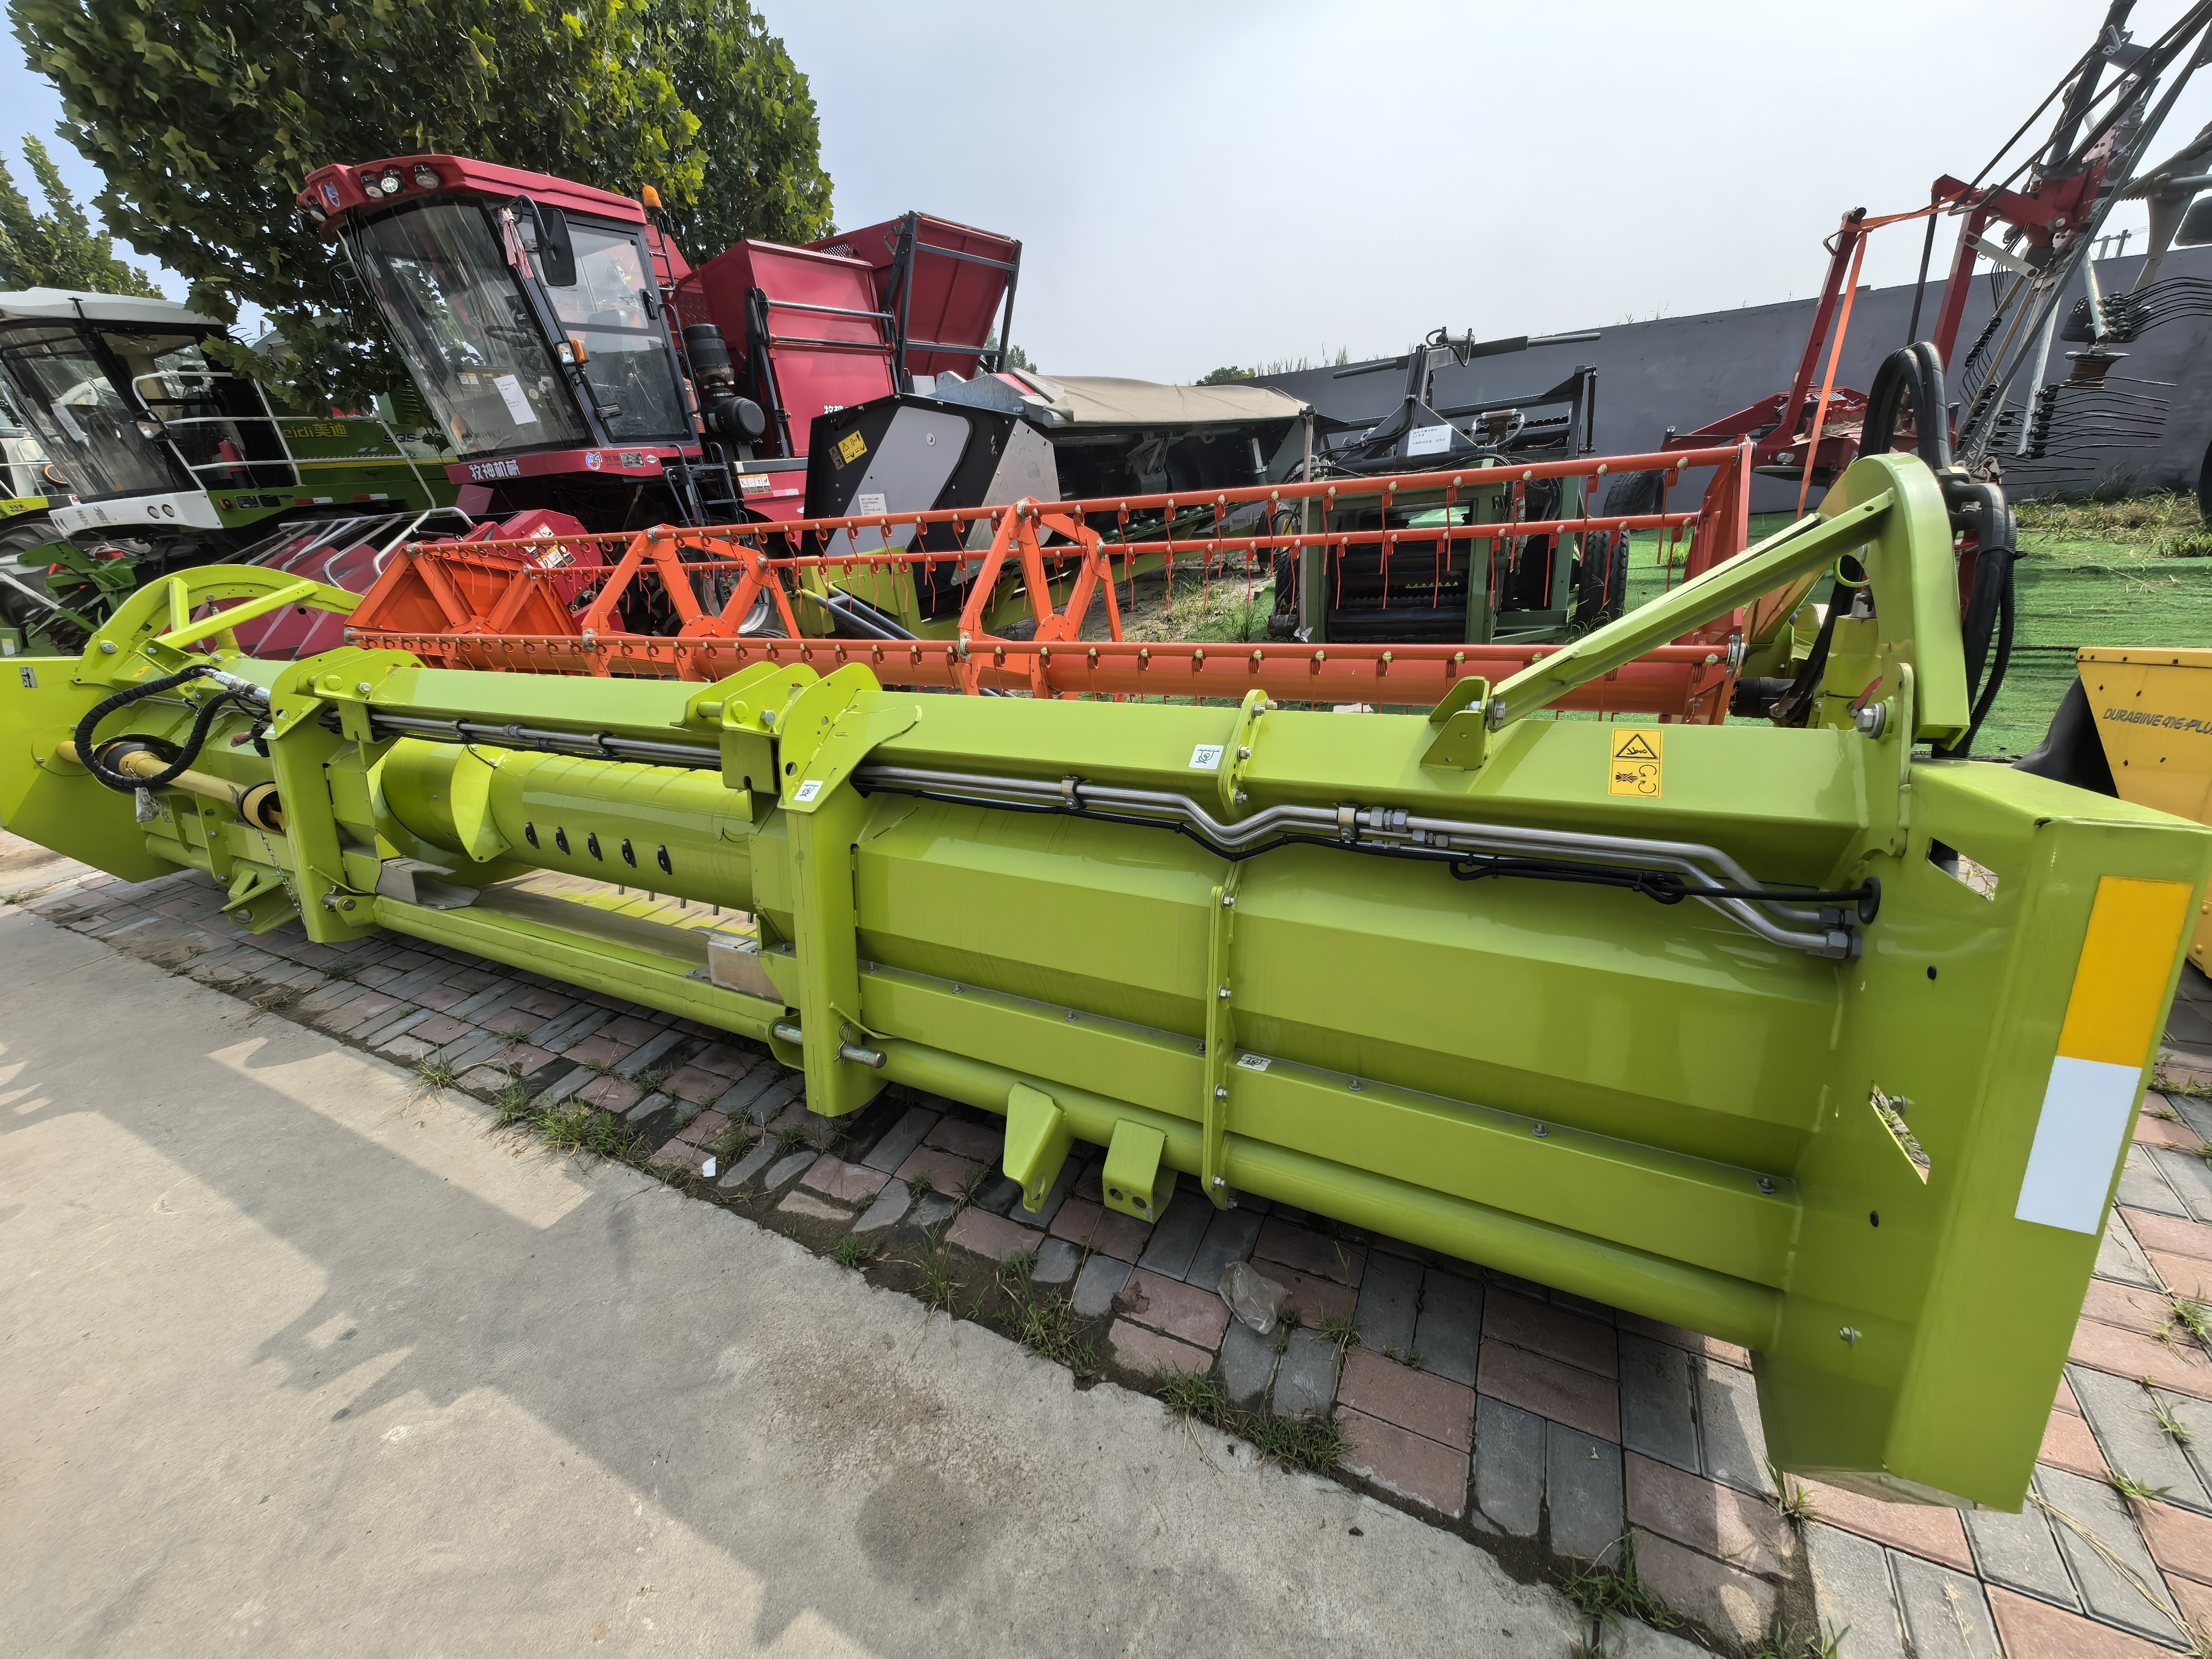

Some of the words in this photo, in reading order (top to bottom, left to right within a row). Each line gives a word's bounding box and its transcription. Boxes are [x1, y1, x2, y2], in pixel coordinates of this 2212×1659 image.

[468, 459, 521, 481] 牧神机械
[2102, 708, 2164, 727] DURABINE
[2162, 716, 2212, 735] 416-PLU
